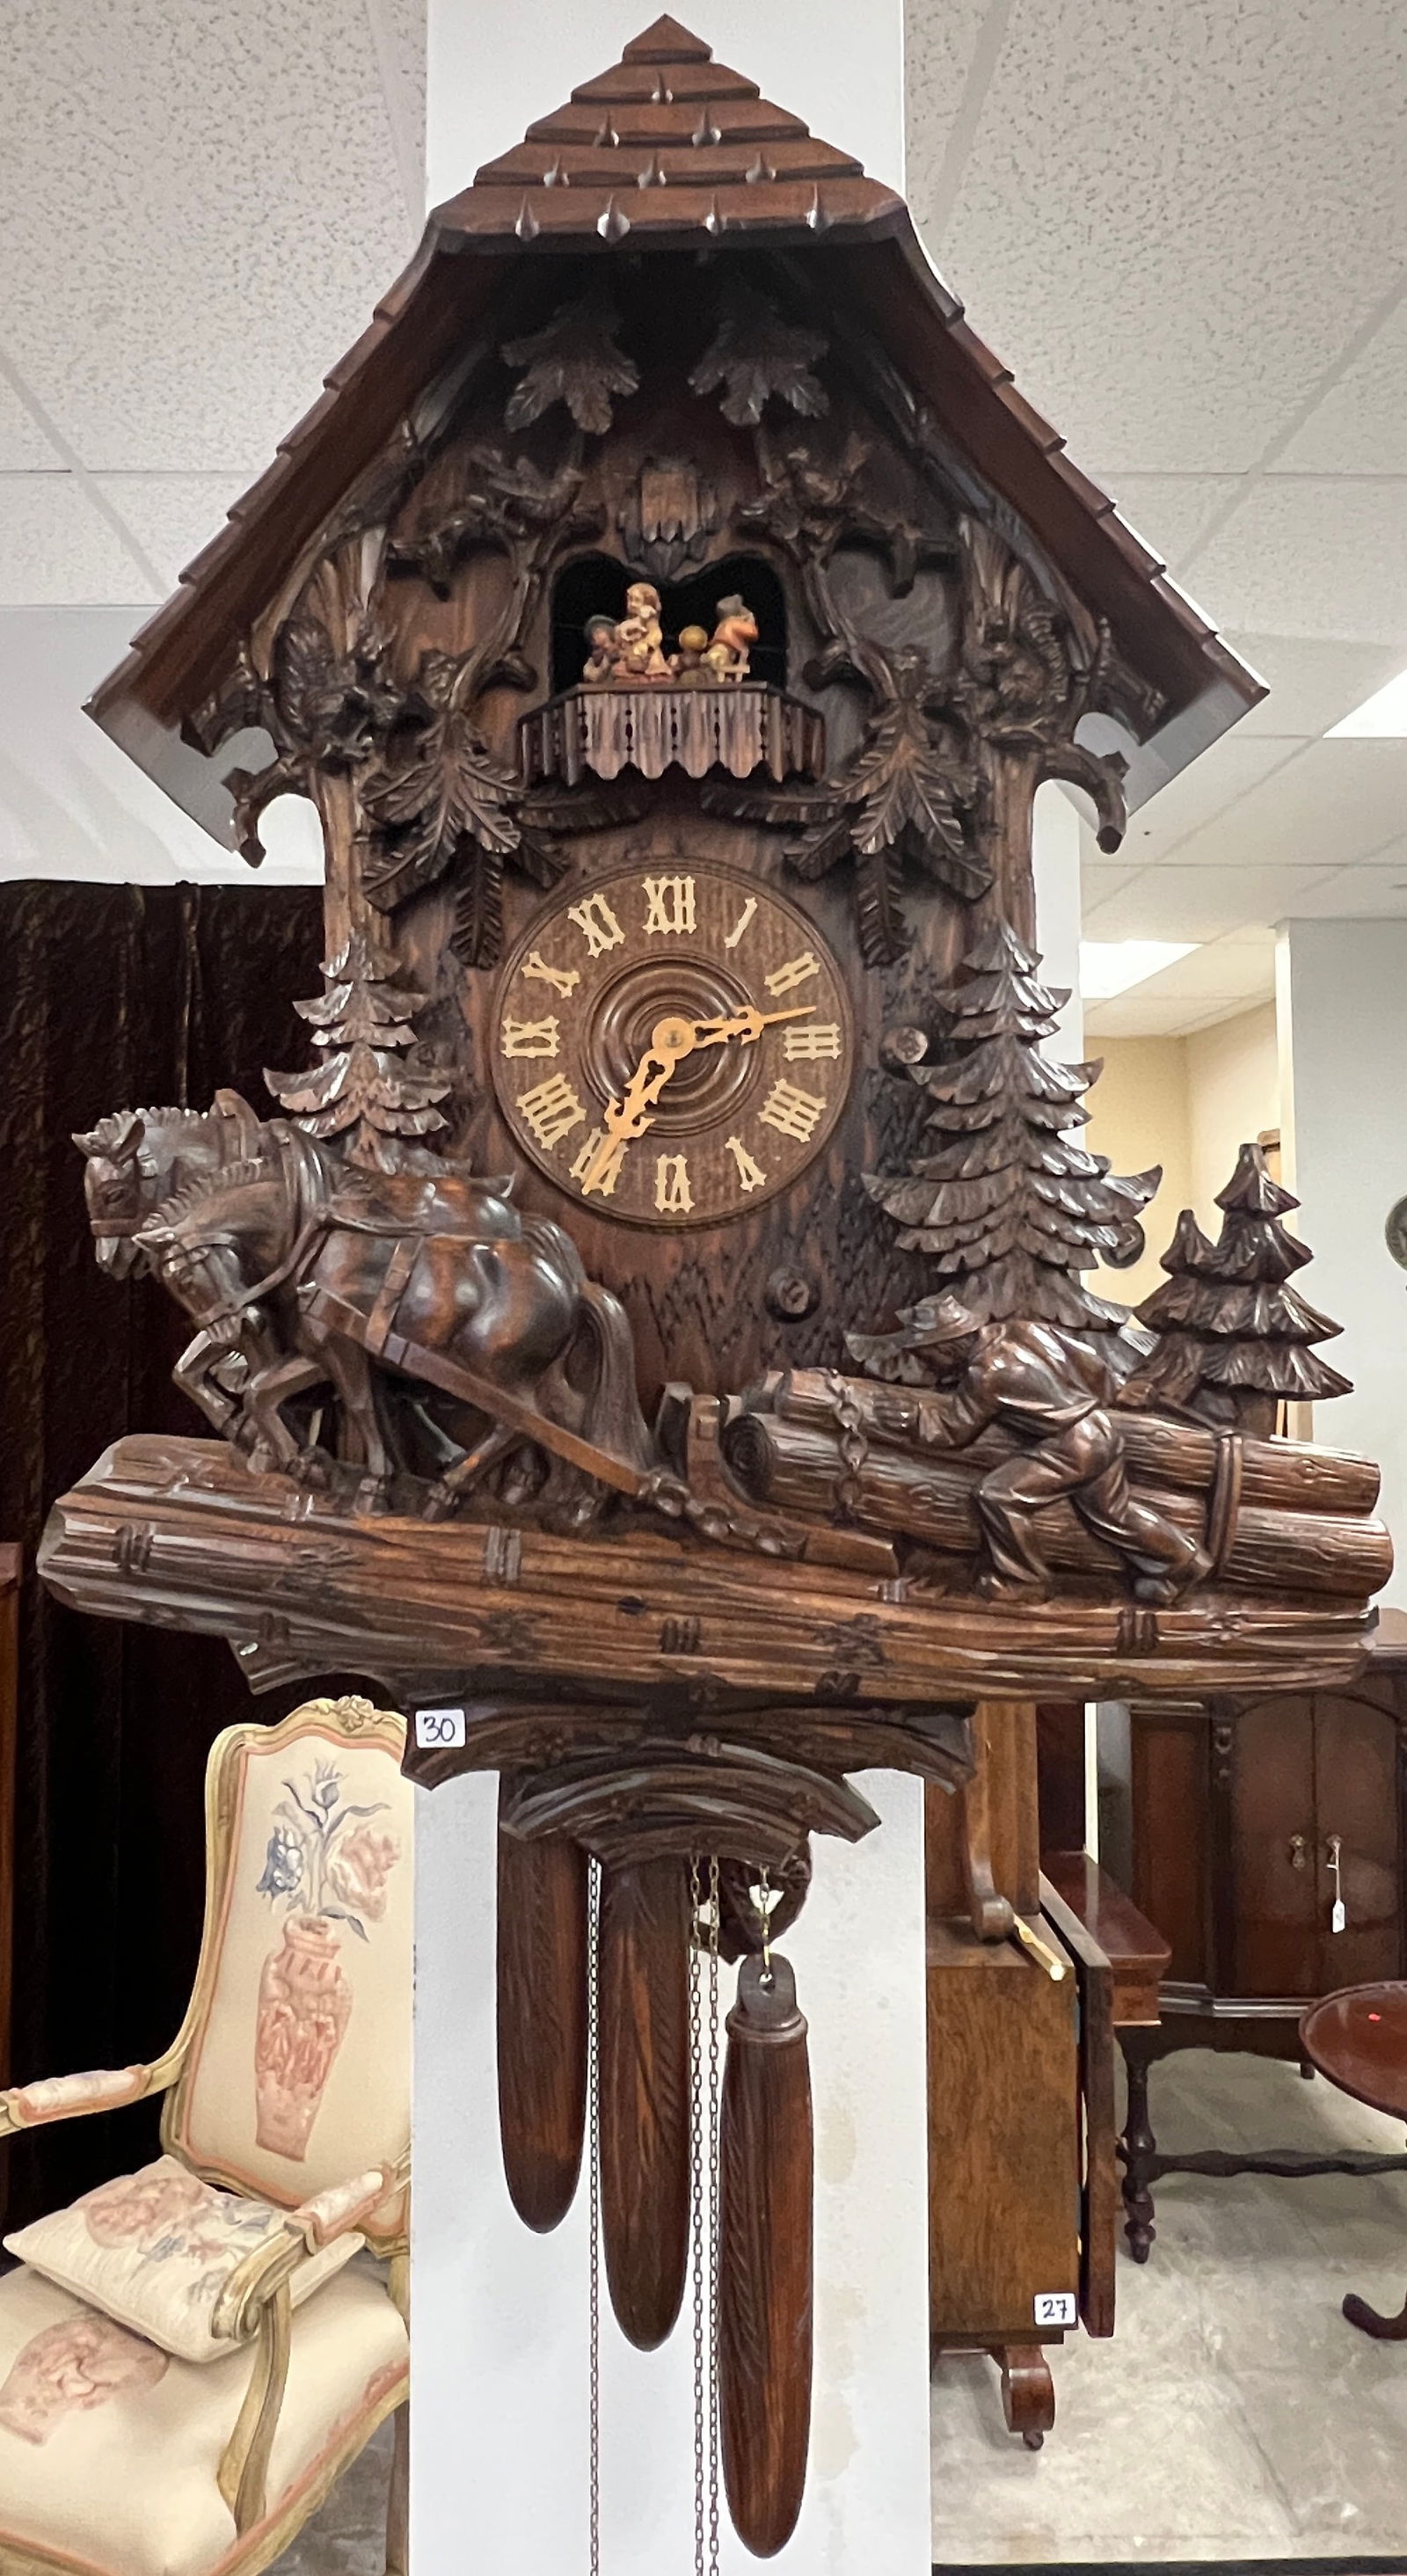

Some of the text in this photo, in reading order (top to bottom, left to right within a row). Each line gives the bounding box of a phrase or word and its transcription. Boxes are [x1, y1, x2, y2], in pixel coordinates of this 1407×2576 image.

[567, 894, 625, 959] XI
[642, 875, 696, 935] XII
[724, 897, 758, 948] I
[521, 951, 580, 999] X
[764, 952, 820, 997] II
[501, 1014, 560, 1059] IX
[782, 1023, 842, 1062] III
[515, 1073, 587, 1150] VIII
[758, 1077, 827, 1143] IIII
[655, 1153, 695, 1214] VI
[725, 1136, 767, 1193] V
[423, 1716, 456, 1742] 30
[1042, 2299, 1068, 2320] 27
